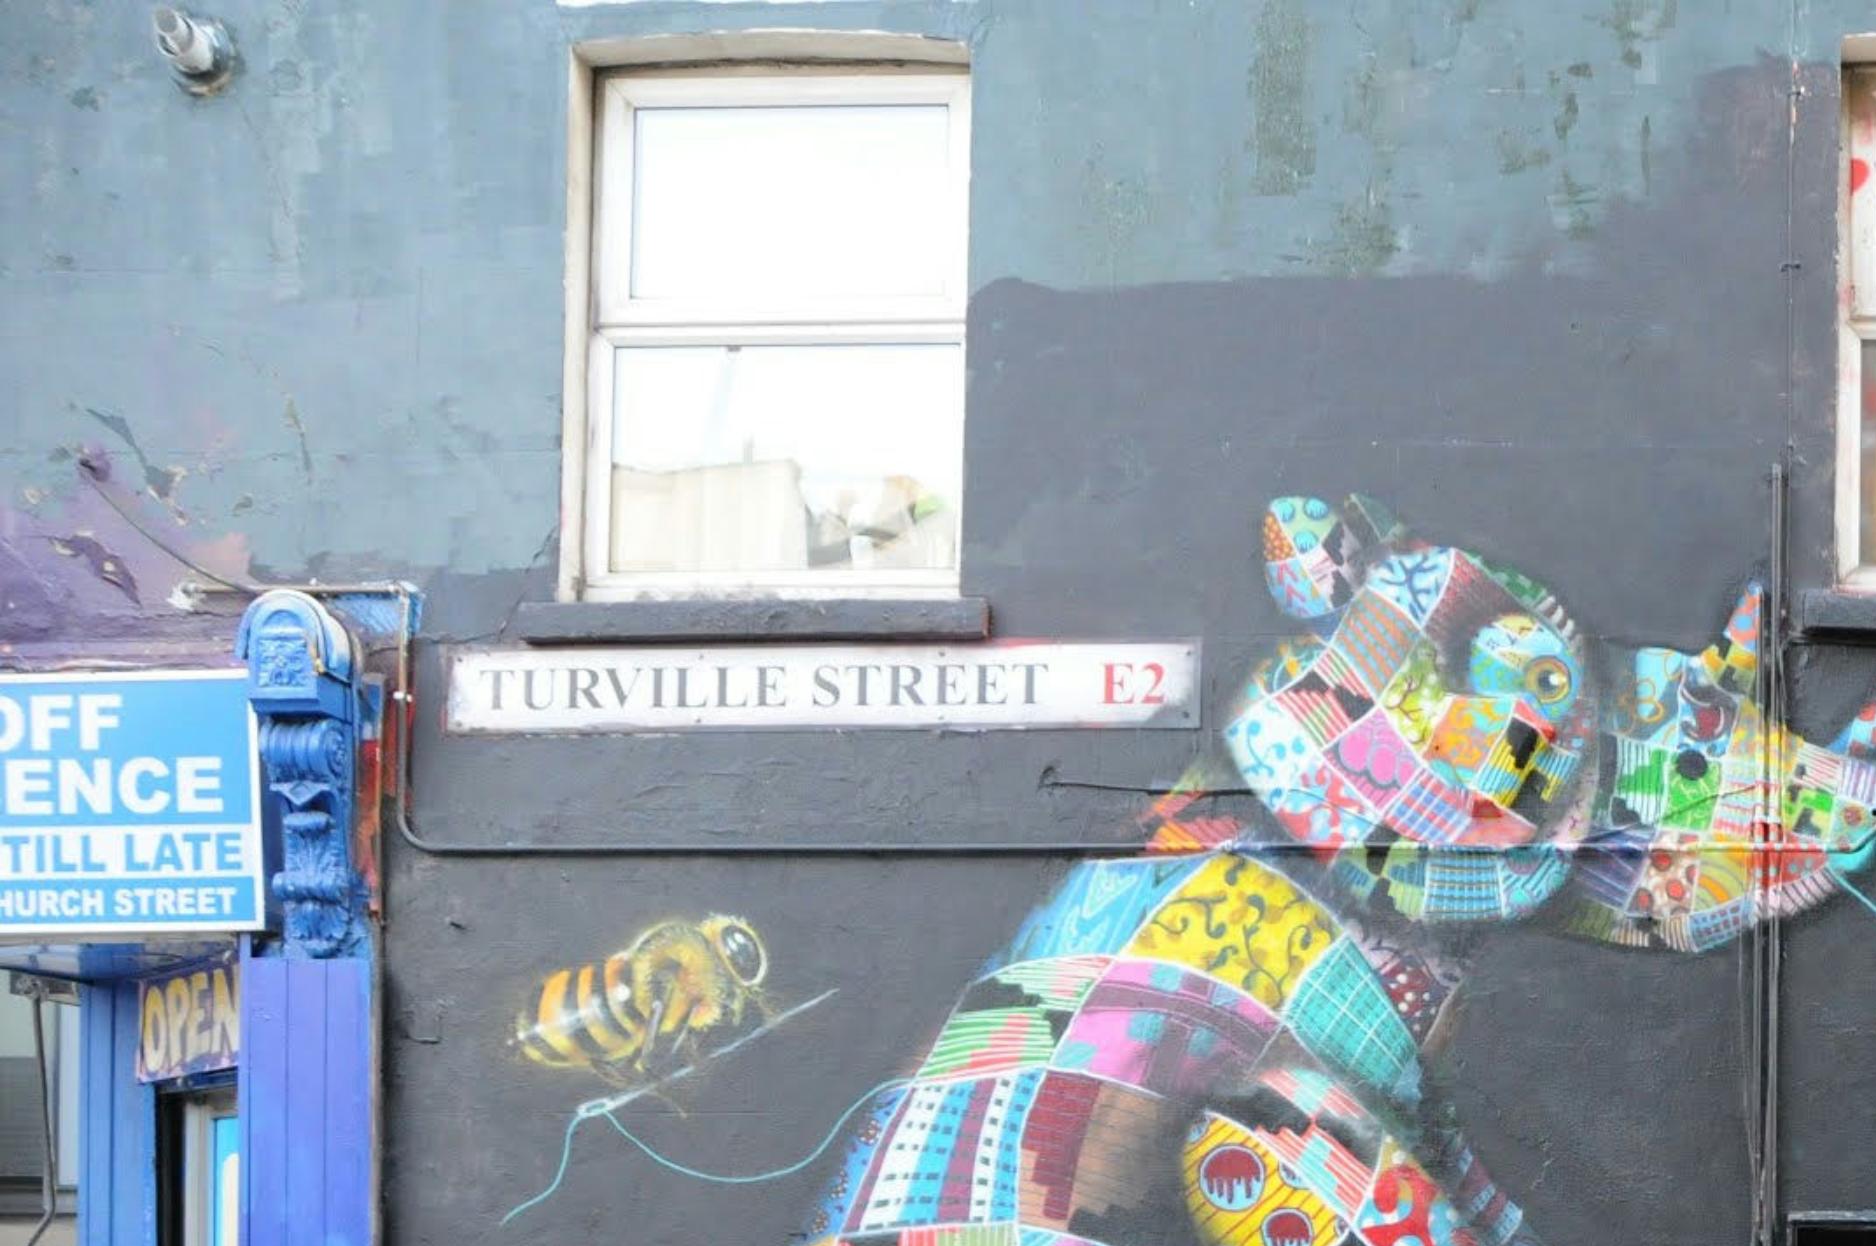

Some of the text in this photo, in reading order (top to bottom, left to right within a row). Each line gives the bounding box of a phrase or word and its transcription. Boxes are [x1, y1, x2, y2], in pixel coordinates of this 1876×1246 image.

[480, 662, 1166, 711] TURVILLE STREET E2
[1, 832, 243, 873] TILL LATE
[114, 886, 237, 916] STREET
[143, 964, 240, 1073] OPEN
